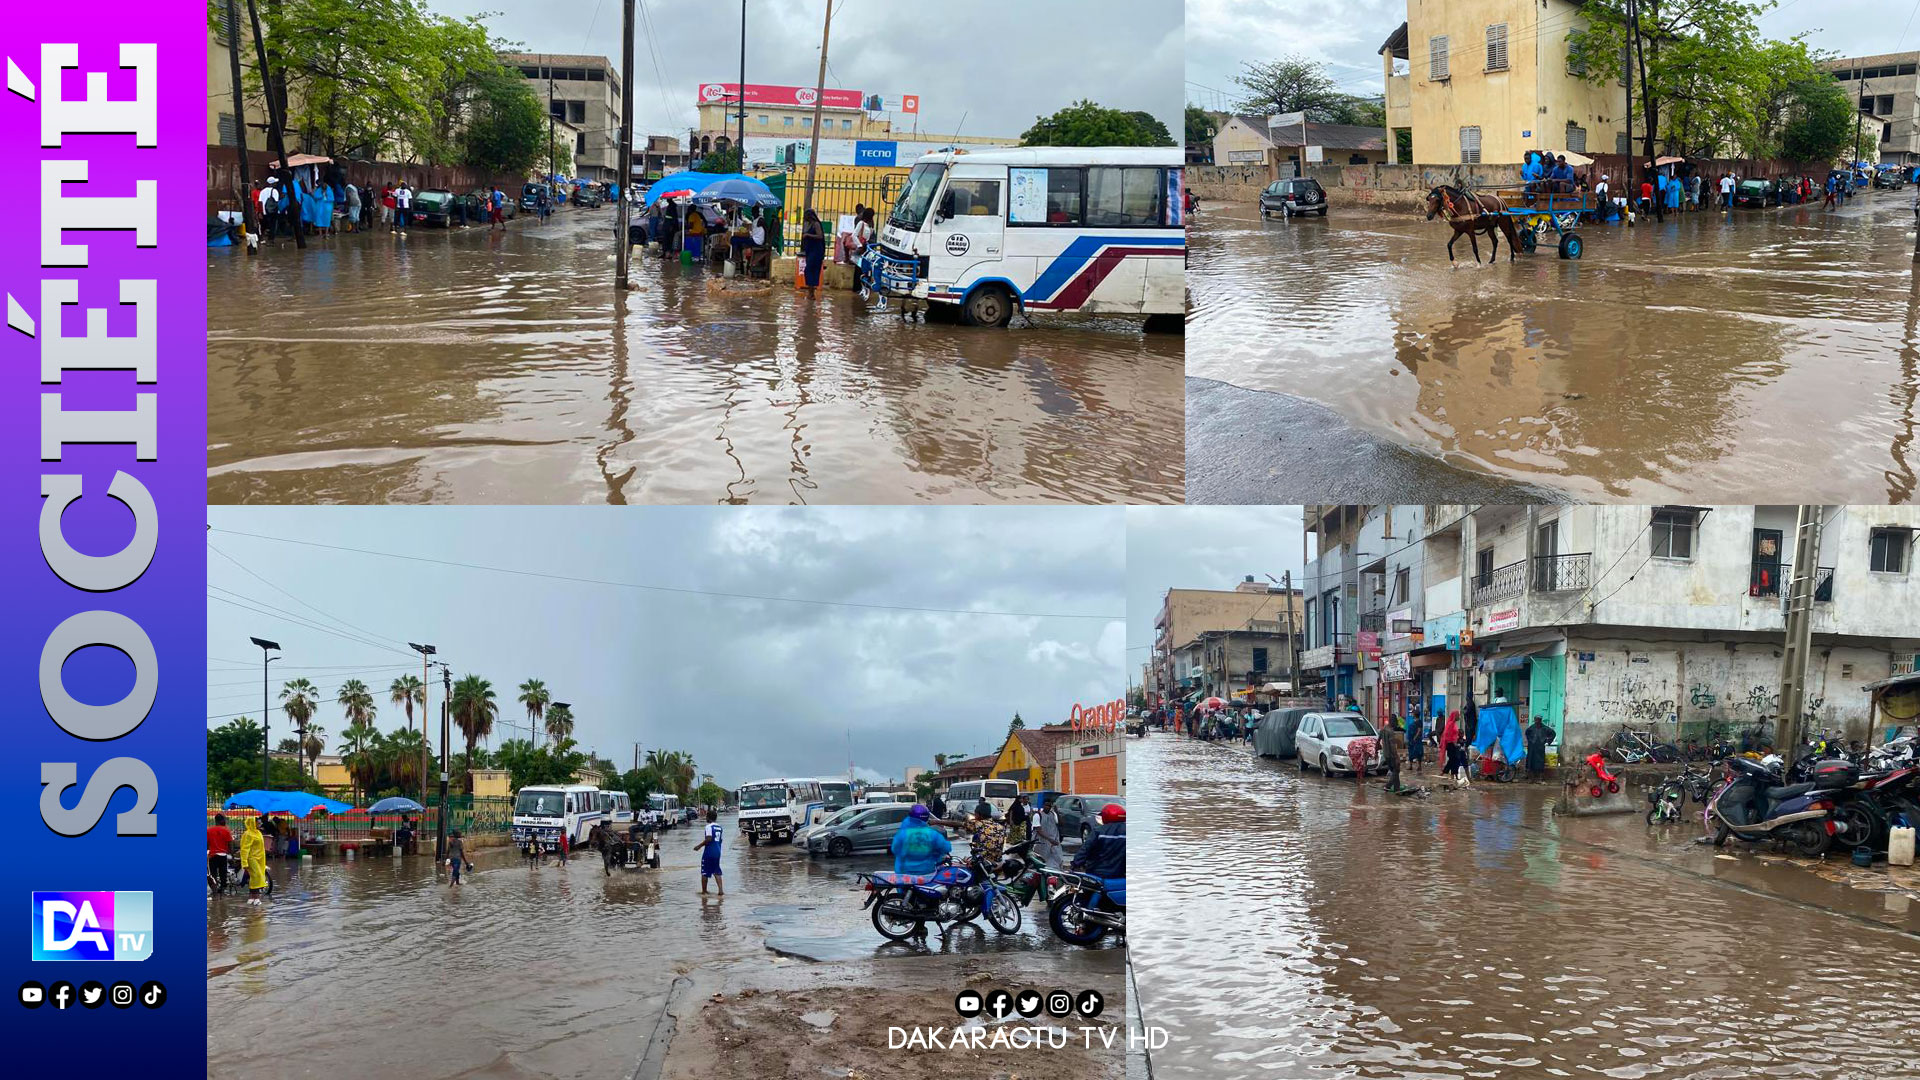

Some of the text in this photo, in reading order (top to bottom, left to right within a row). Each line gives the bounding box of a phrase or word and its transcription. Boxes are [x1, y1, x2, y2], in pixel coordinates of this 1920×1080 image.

[800, 91, 814, 100] itel
[861, 149, 891, 158] TECNO
[1891, 663, 1912, 674] PMU
[1071, 698, 1126, 733] Orange
